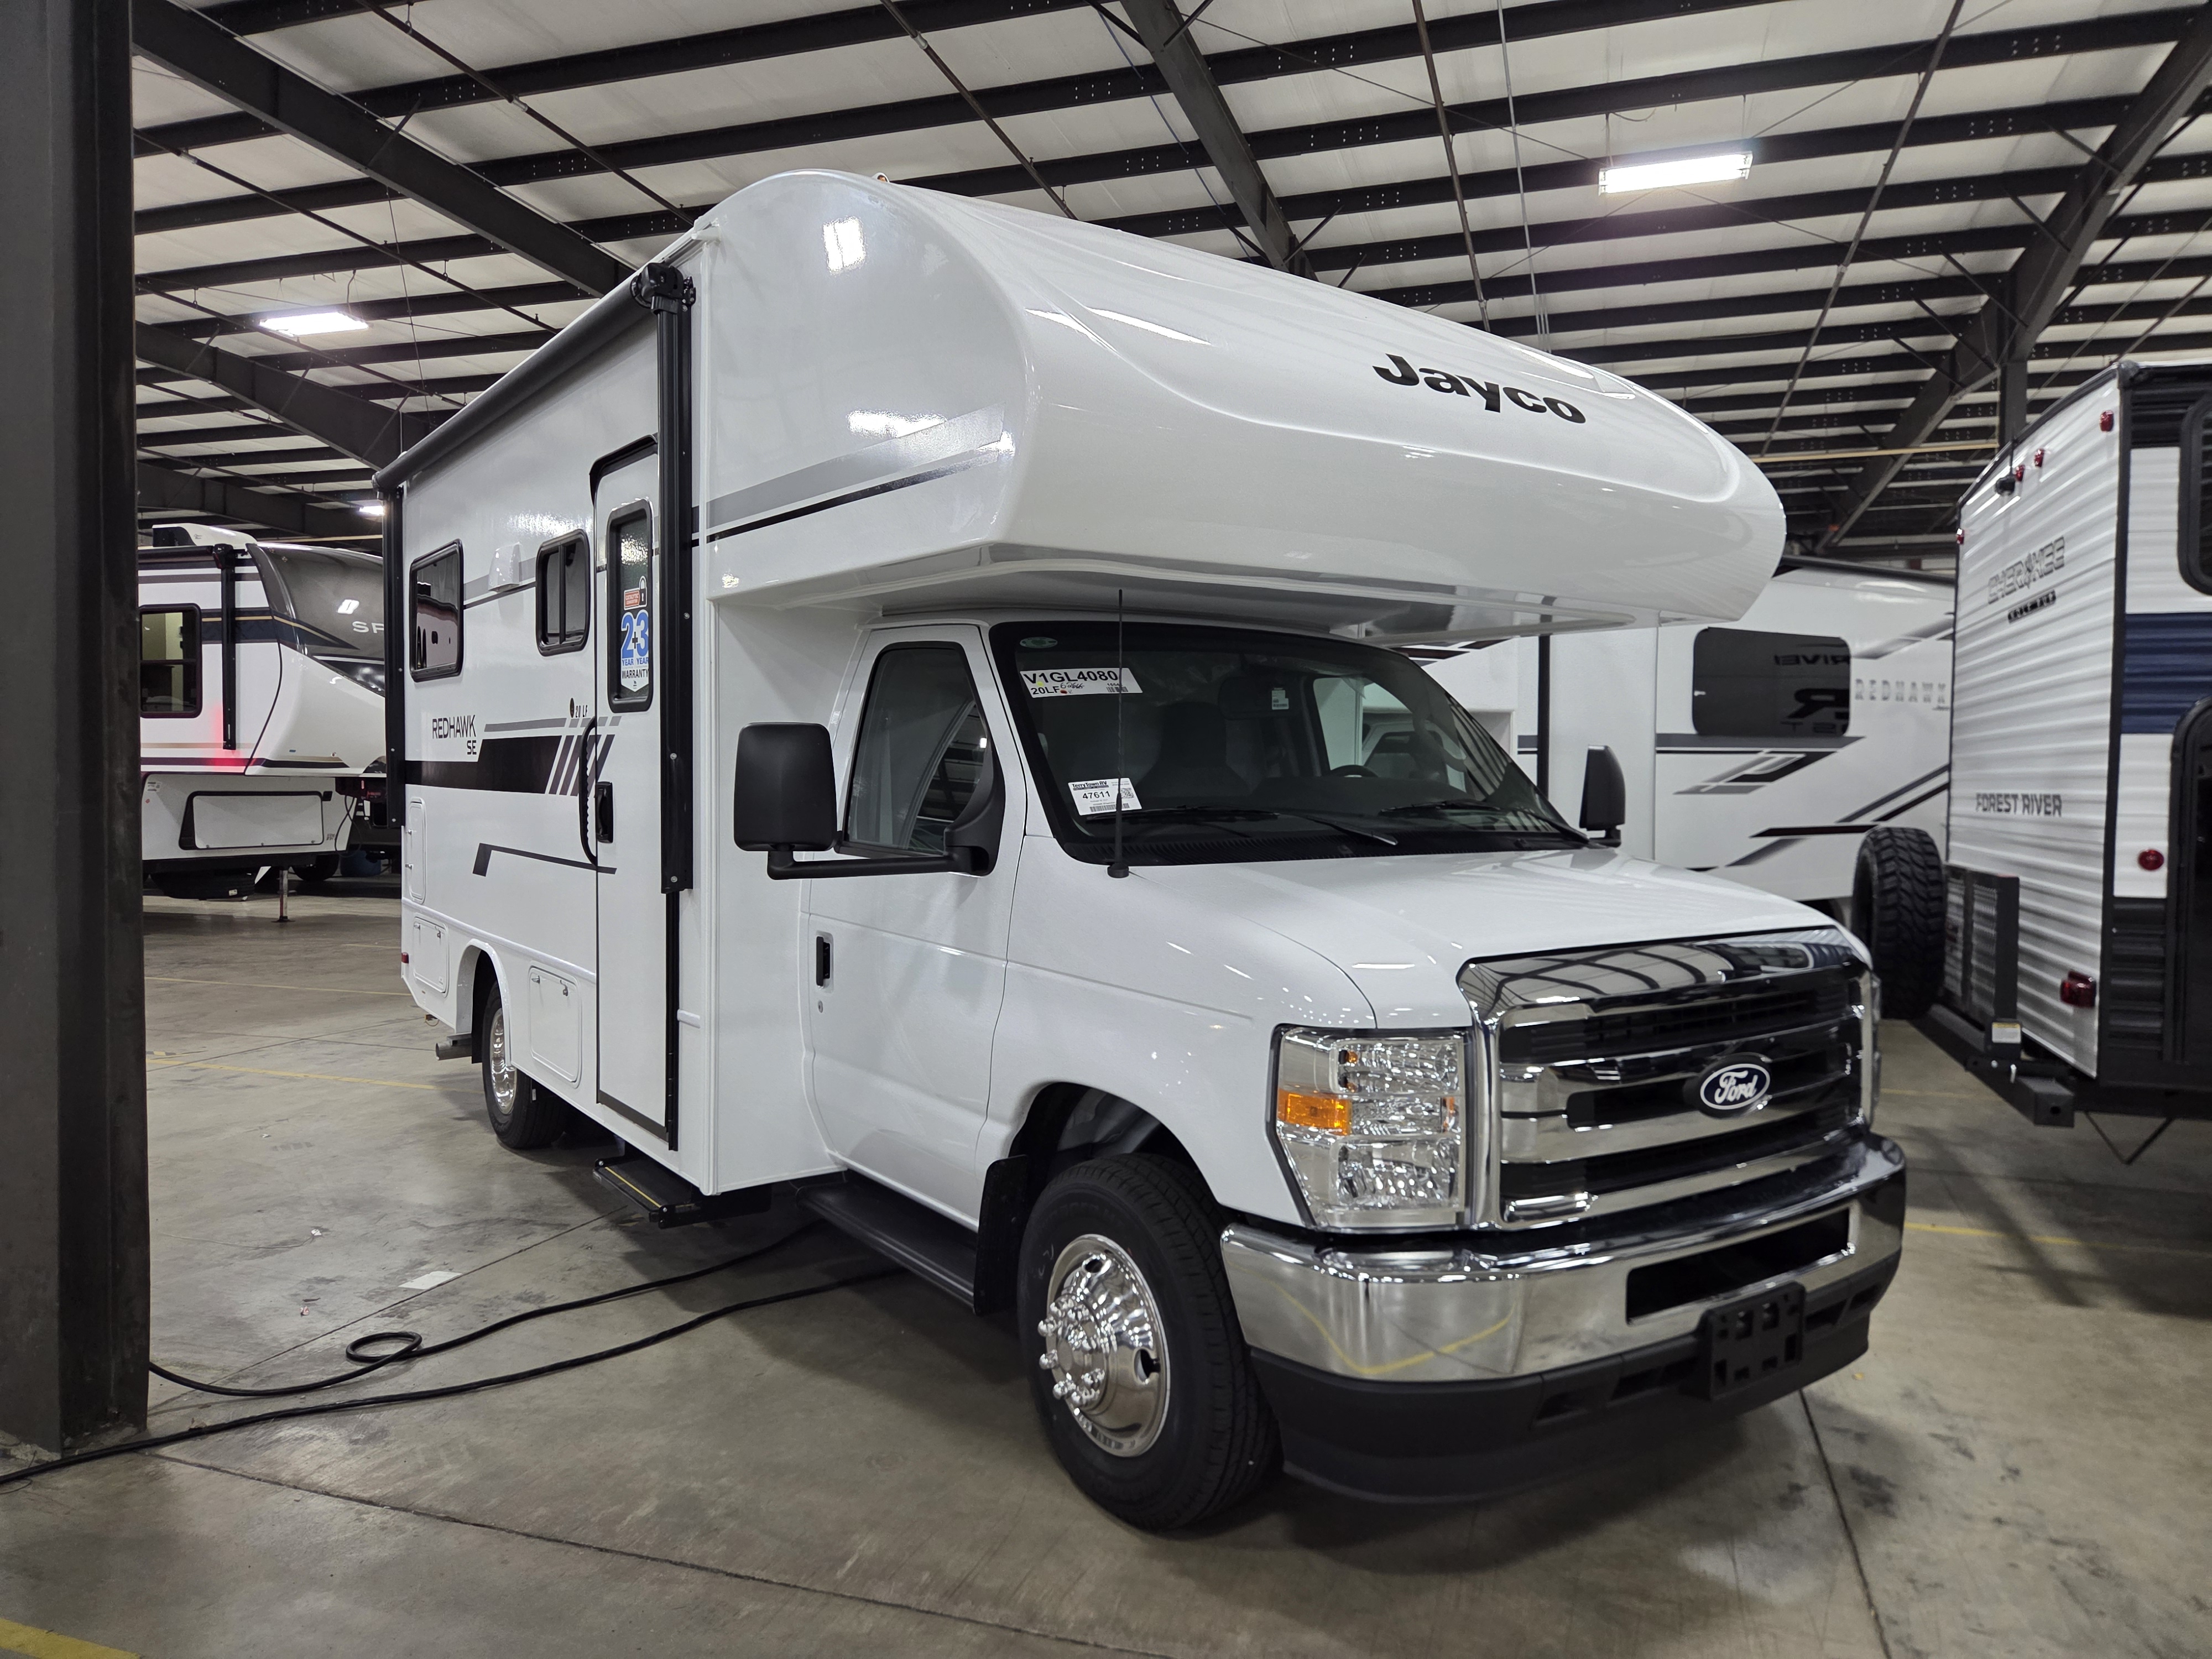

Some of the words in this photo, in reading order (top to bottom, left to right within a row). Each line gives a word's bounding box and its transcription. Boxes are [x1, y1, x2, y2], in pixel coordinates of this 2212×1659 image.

[1373, 353, 1586, 424] Jayco
[622, 669, 649, 679] WARRANTY
[1023, 670, 1118, 684] V1GL4080
[1031, 686, 1060, 695] 20LF
[432, 714, 476, 739] REDHAWK
[467, 740, 477, 755] SE
[1082, 791, 1110, 799] 47611
[1976, 792, 2018, 815] FOREST
[2021, 793, 2062, 817] RIVER
[1714, 1070, 1759, 1104] Ford
